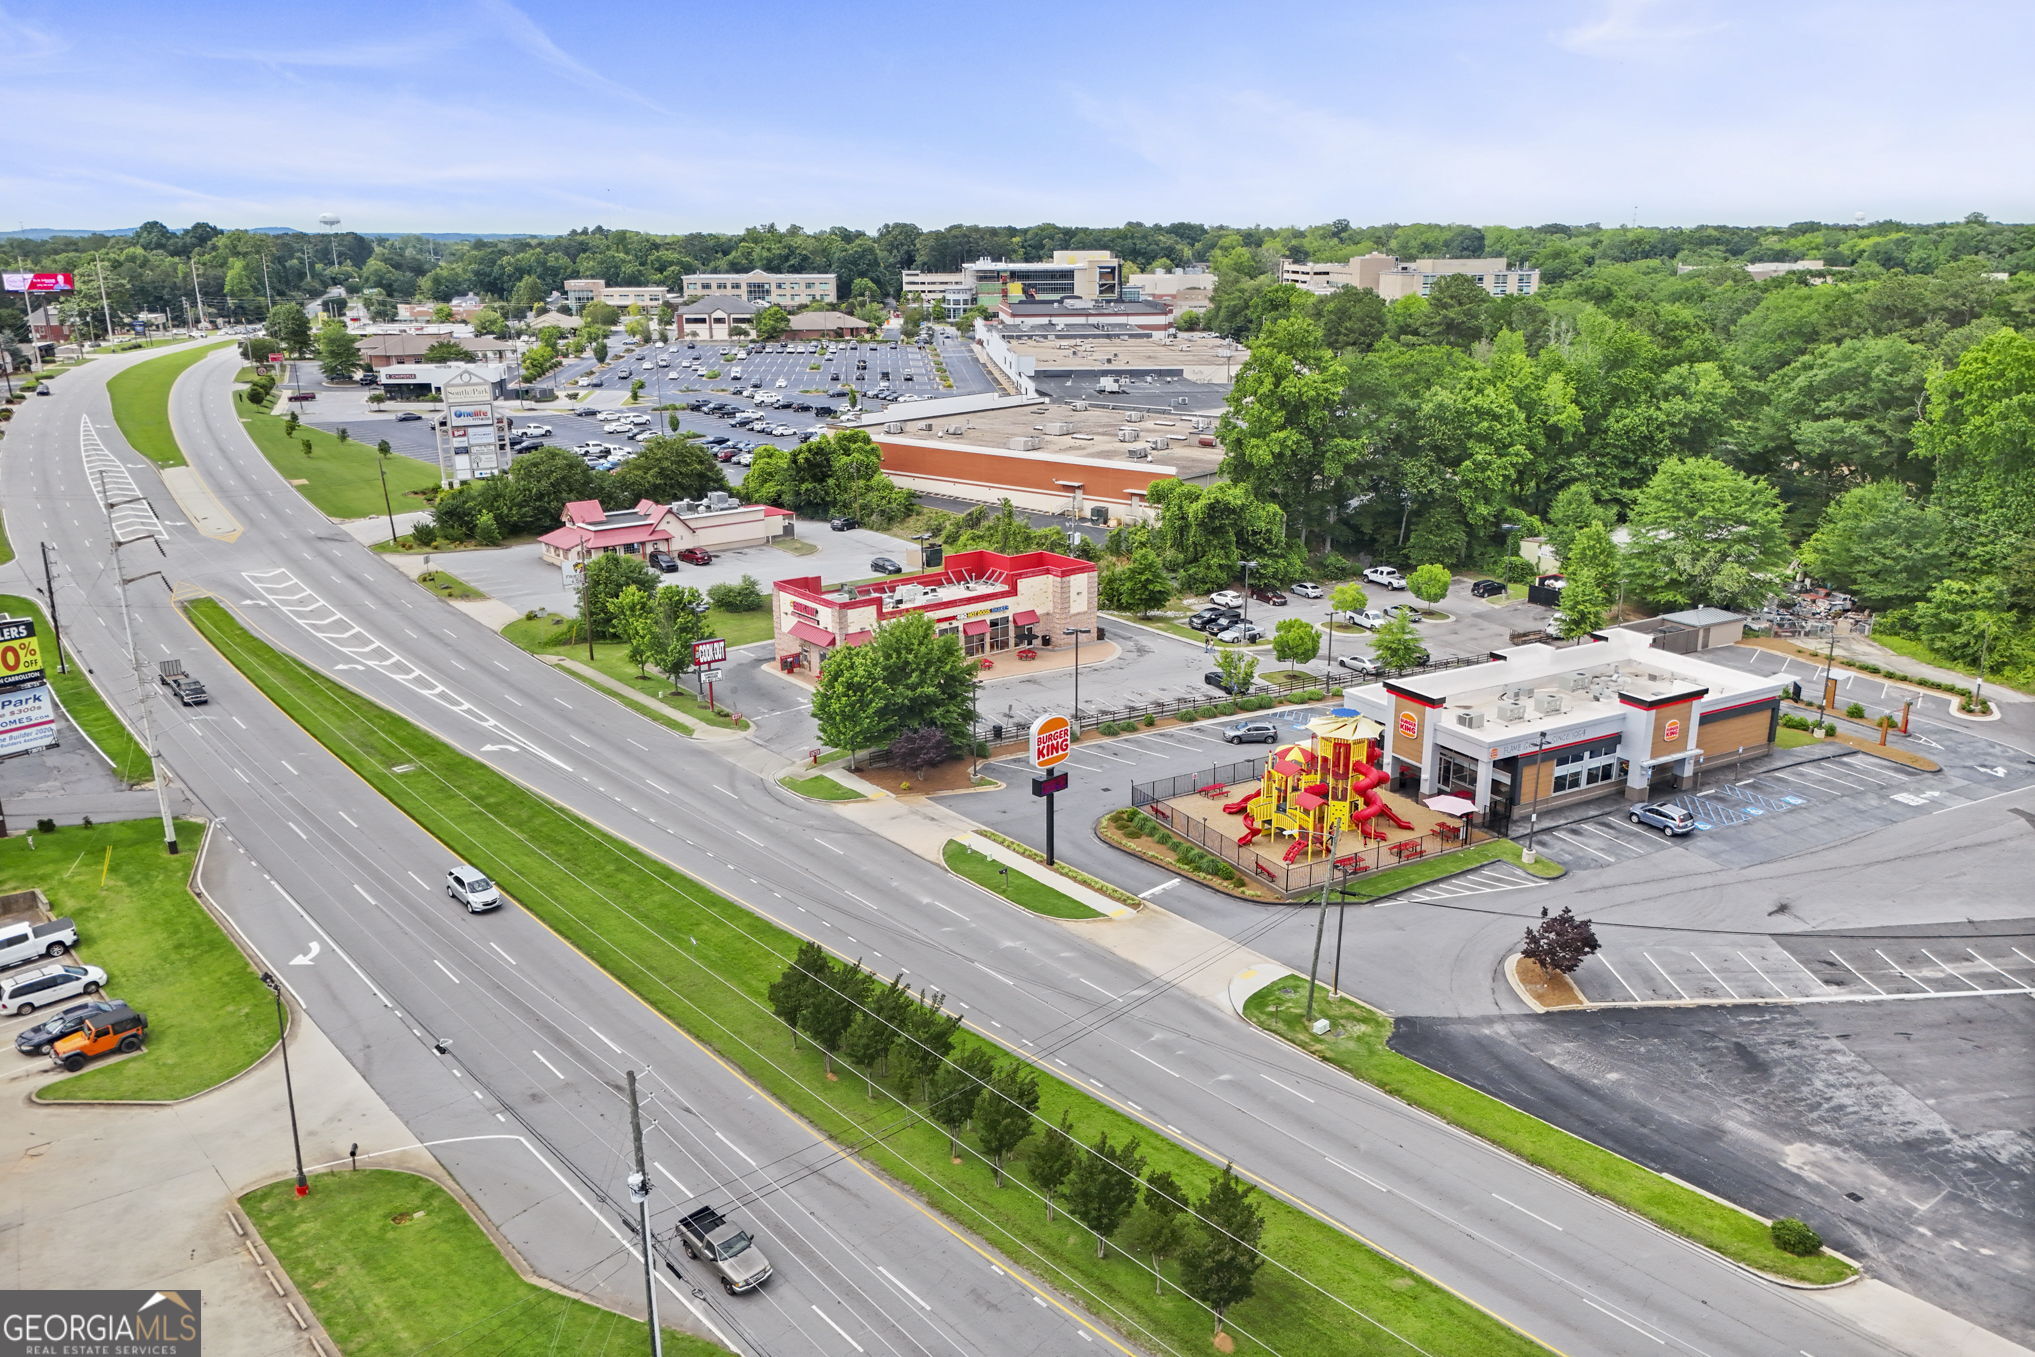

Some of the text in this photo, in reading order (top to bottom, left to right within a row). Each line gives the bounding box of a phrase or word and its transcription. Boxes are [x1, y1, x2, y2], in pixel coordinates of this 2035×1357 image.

[454, 409, 488, 418] Onelife
[23, 659, 38, 668] OFF
[4, 672, 40, 683] CARROLLTON
[1, 694, 43, 710] Park
[9, 731, 33, 741] Builder
[1037, 728, 1069, 746] BURGER
[1037, 738, 1069, 760] KING
